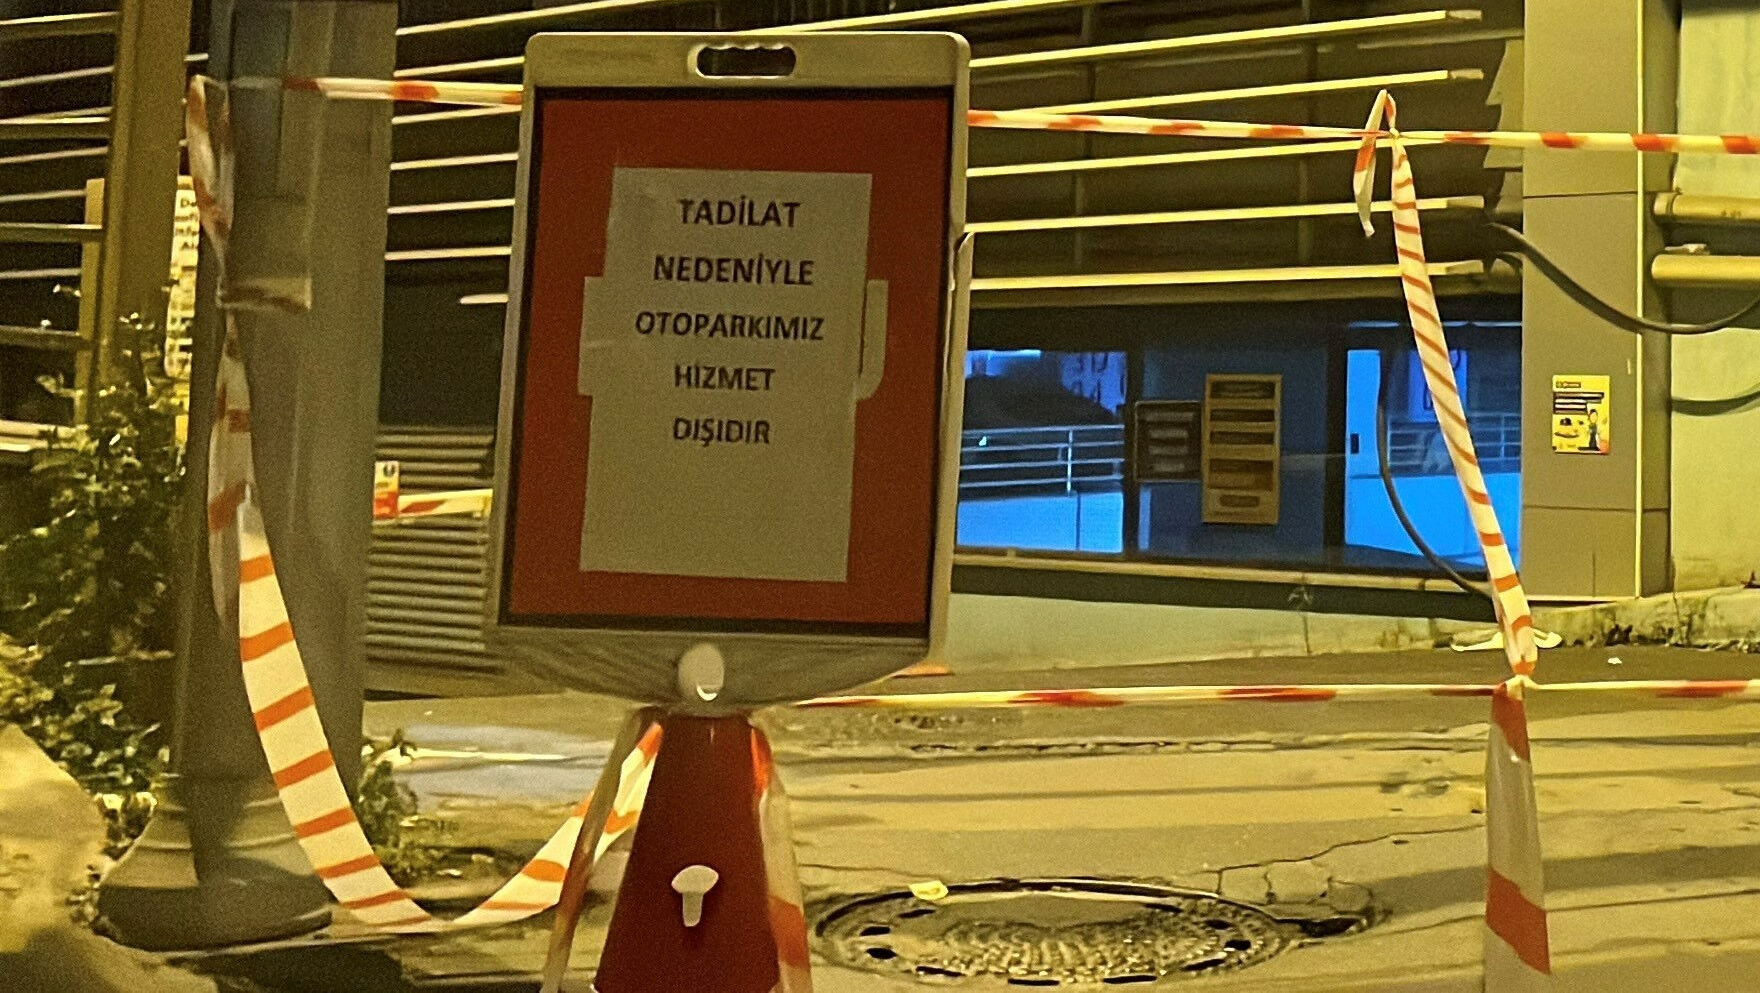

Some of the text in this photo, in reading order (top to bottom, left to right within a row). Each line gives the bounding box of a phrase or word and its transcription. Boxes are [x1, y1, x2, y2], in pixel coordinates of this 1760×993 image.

[677, 194, 801, 228] TADİLAT
[653, 253, 815, 286] NEDENİYLE
[635, 310, 825, 341] OTOPARKIMIZ
[672, 417, 771, 448] DIŞIDIR
